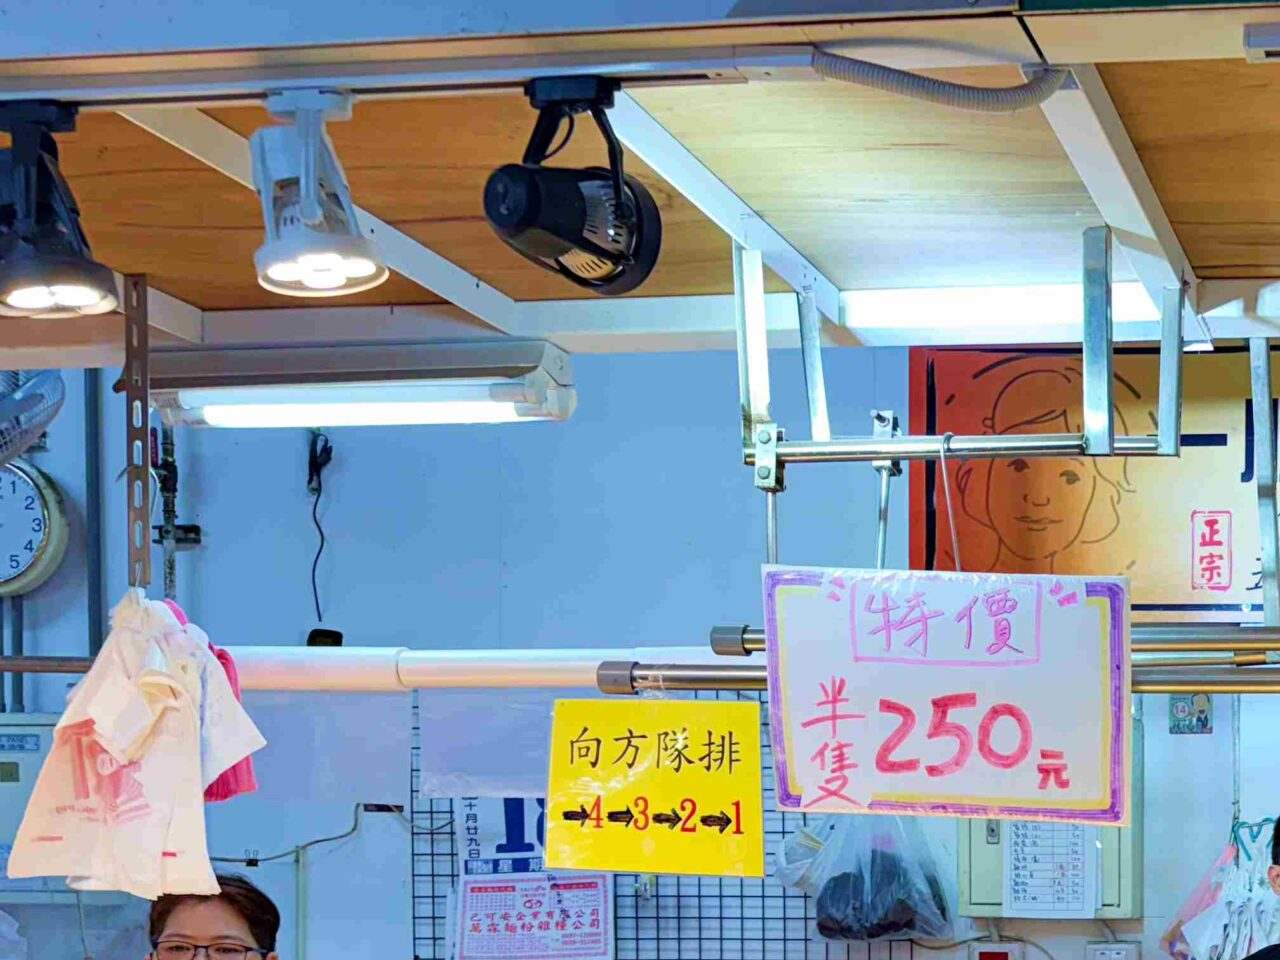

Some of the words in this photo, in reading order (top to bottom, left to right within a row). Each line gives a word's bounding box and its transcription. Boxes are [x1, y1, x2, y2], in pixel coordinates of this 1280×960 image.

[9, 480, 17, 494] 1
[24, 496, 35, 510] 2
[31, 518, 43, 533] 3
[23, 539, 35, 553] 4
[1198, 518, 1224, 583] 正宗
[9, 554, 21, 569] 5
[863, 588, 1025, 657] 特價
[801, 675, 867, 808] 半隻
[588, 795, 604, 828] 4
[633, 796, 650, 831] 3
[680, 798, 698, 832] 2
[731, 800, 744, 834] 1
